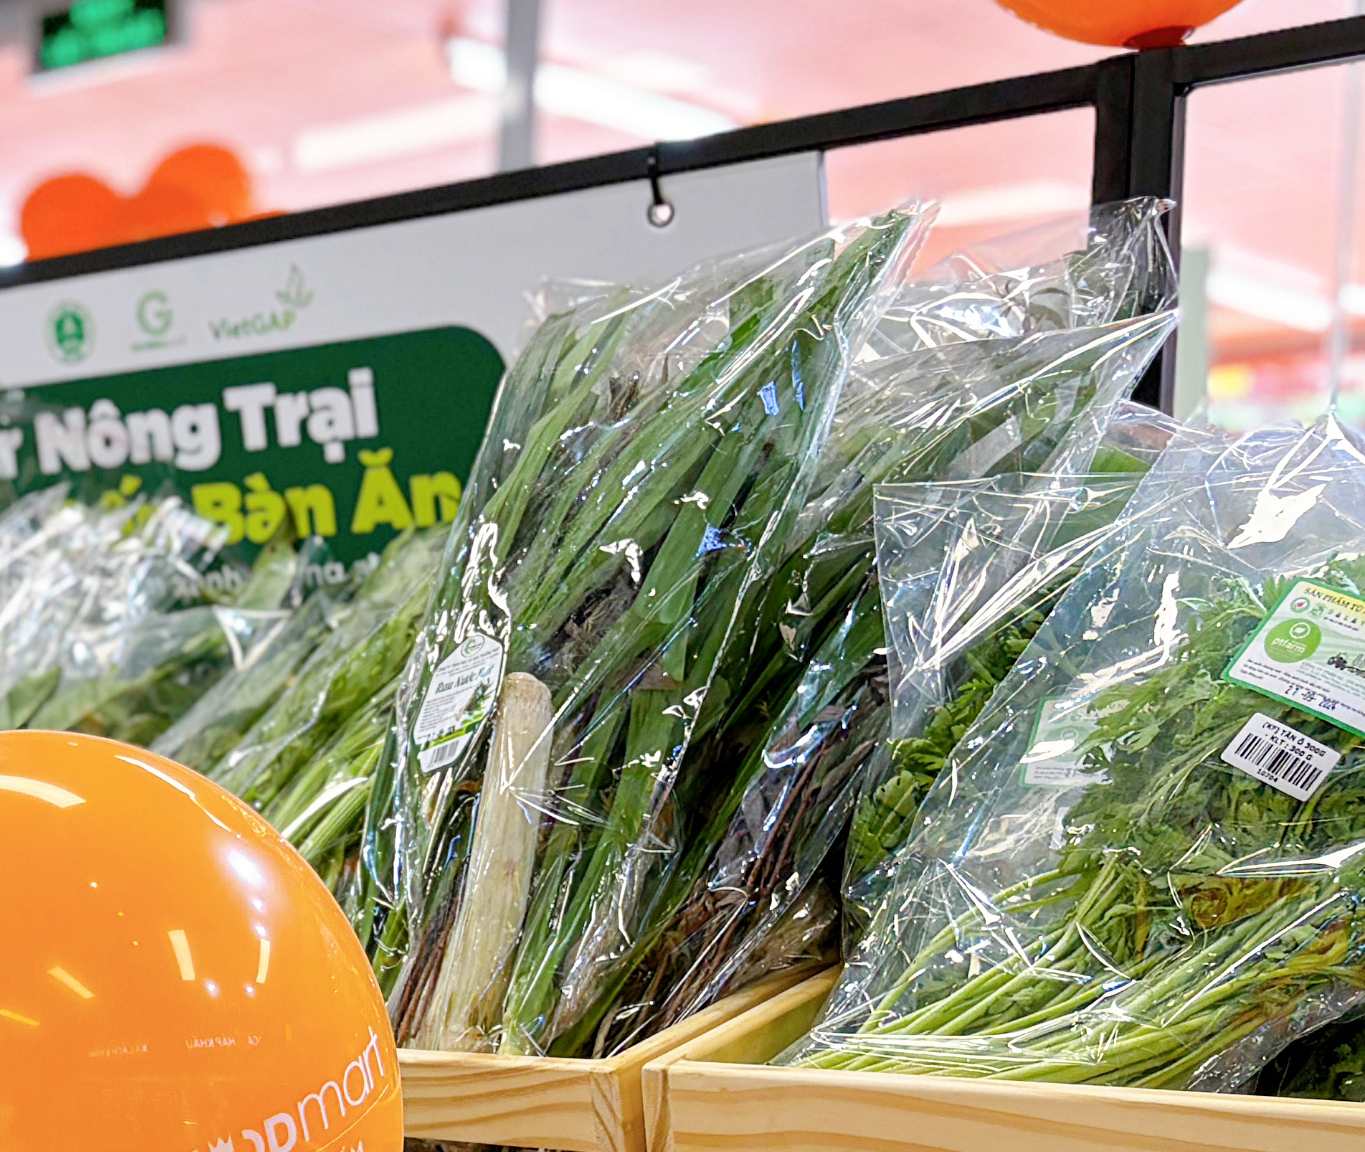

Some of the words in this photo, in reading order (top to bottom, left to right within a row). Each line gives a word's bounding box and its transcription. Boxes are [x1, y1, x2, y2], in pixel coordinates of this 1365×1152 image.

[208, 310, 296, 340] VietGAP
[34, 397, 222, 476] Nông
[223, 367, 379, 464] Trại
[191, 471, 337, 545] Bàn
[351, 447, 462, 535] Ăn
[1270, 636, 1307, 654] ptfarm
